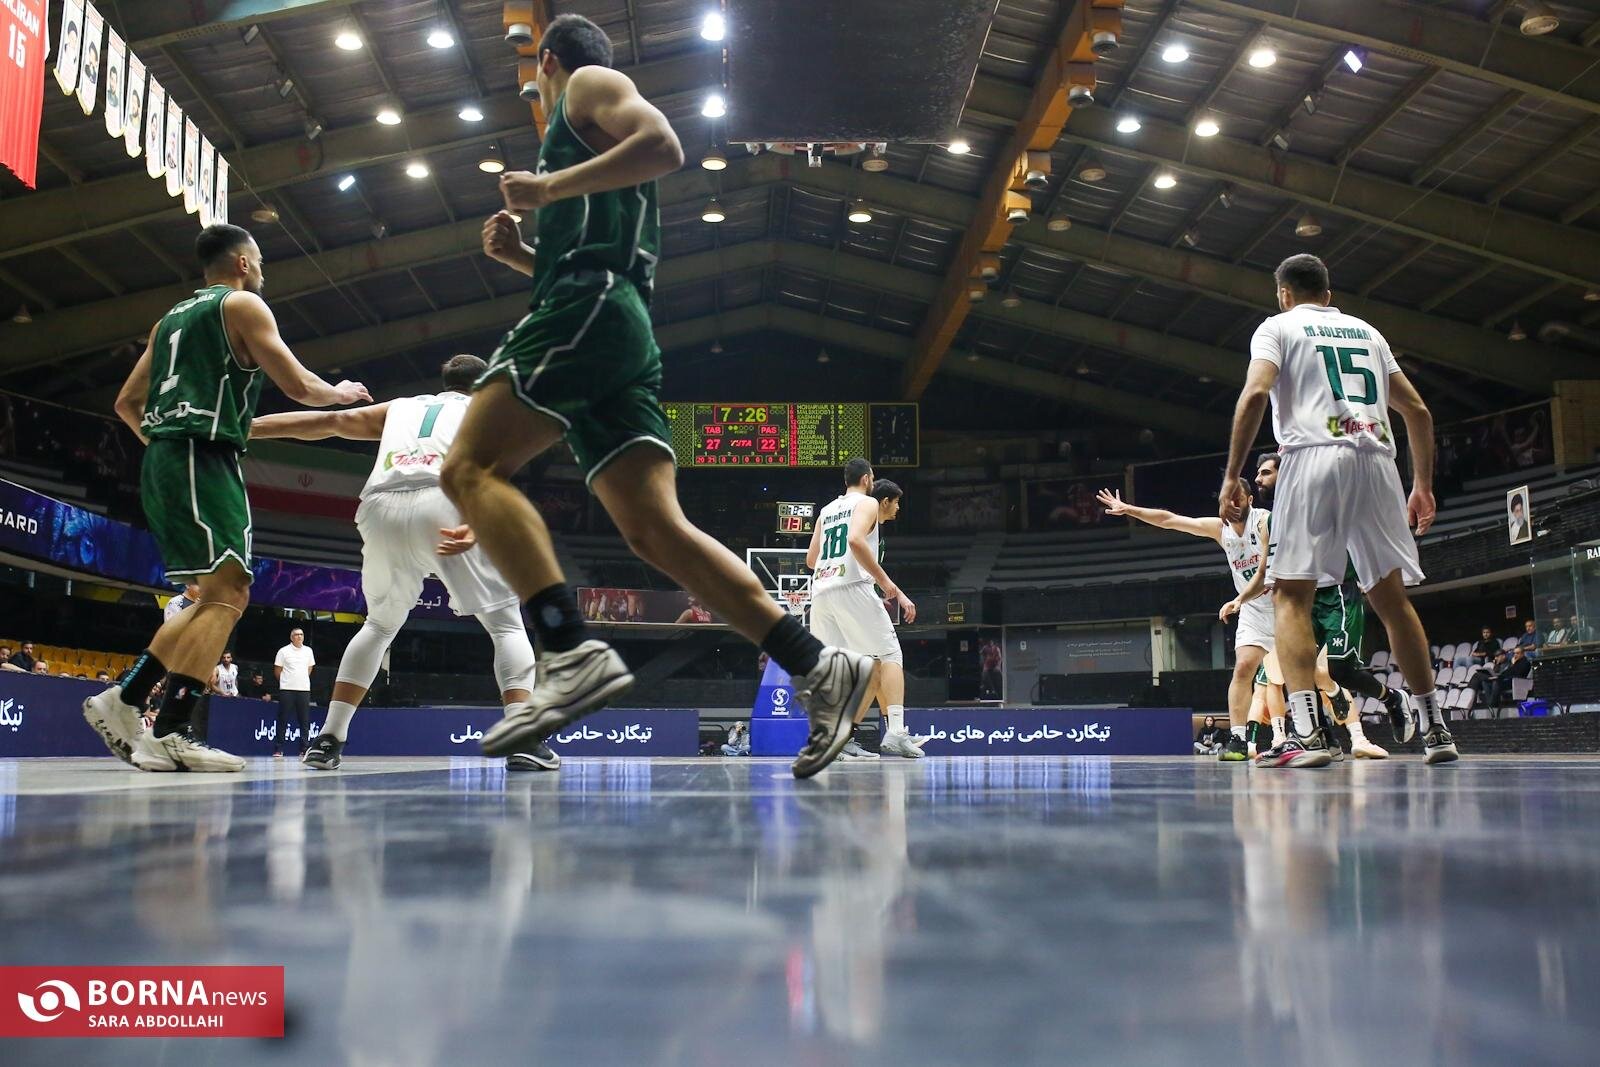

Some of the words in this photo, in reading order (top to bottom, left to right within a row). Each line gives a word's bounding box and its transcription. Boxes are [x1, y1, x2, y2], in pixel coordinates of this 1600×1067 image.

[8, 23, 27, 69] 15
[159, 328, 182, 395] 1
[1315, 345, 1378, 405] 15
[417, 403, 445, 438] 1
[704, 426, 721, 434] TAB
[761, 426, 777, 434] PAS
[706, 439, 720, 450] 27
[761, 439, 776, 450] 22
[821, 523, 849, 560] 18
[1587, 546, 1600, 560] RA
[450, 725, 483, 744] ملی
[556, 725, 603, 744] حامی
[606, 723, 653, 743] تیگارد
[950, 725, 985, 743] های
[988, 726, 1015, 744] تیم
[1017, 724, 1063, 743] حامی
[1066, 723, 1111, 742] تیگارد
